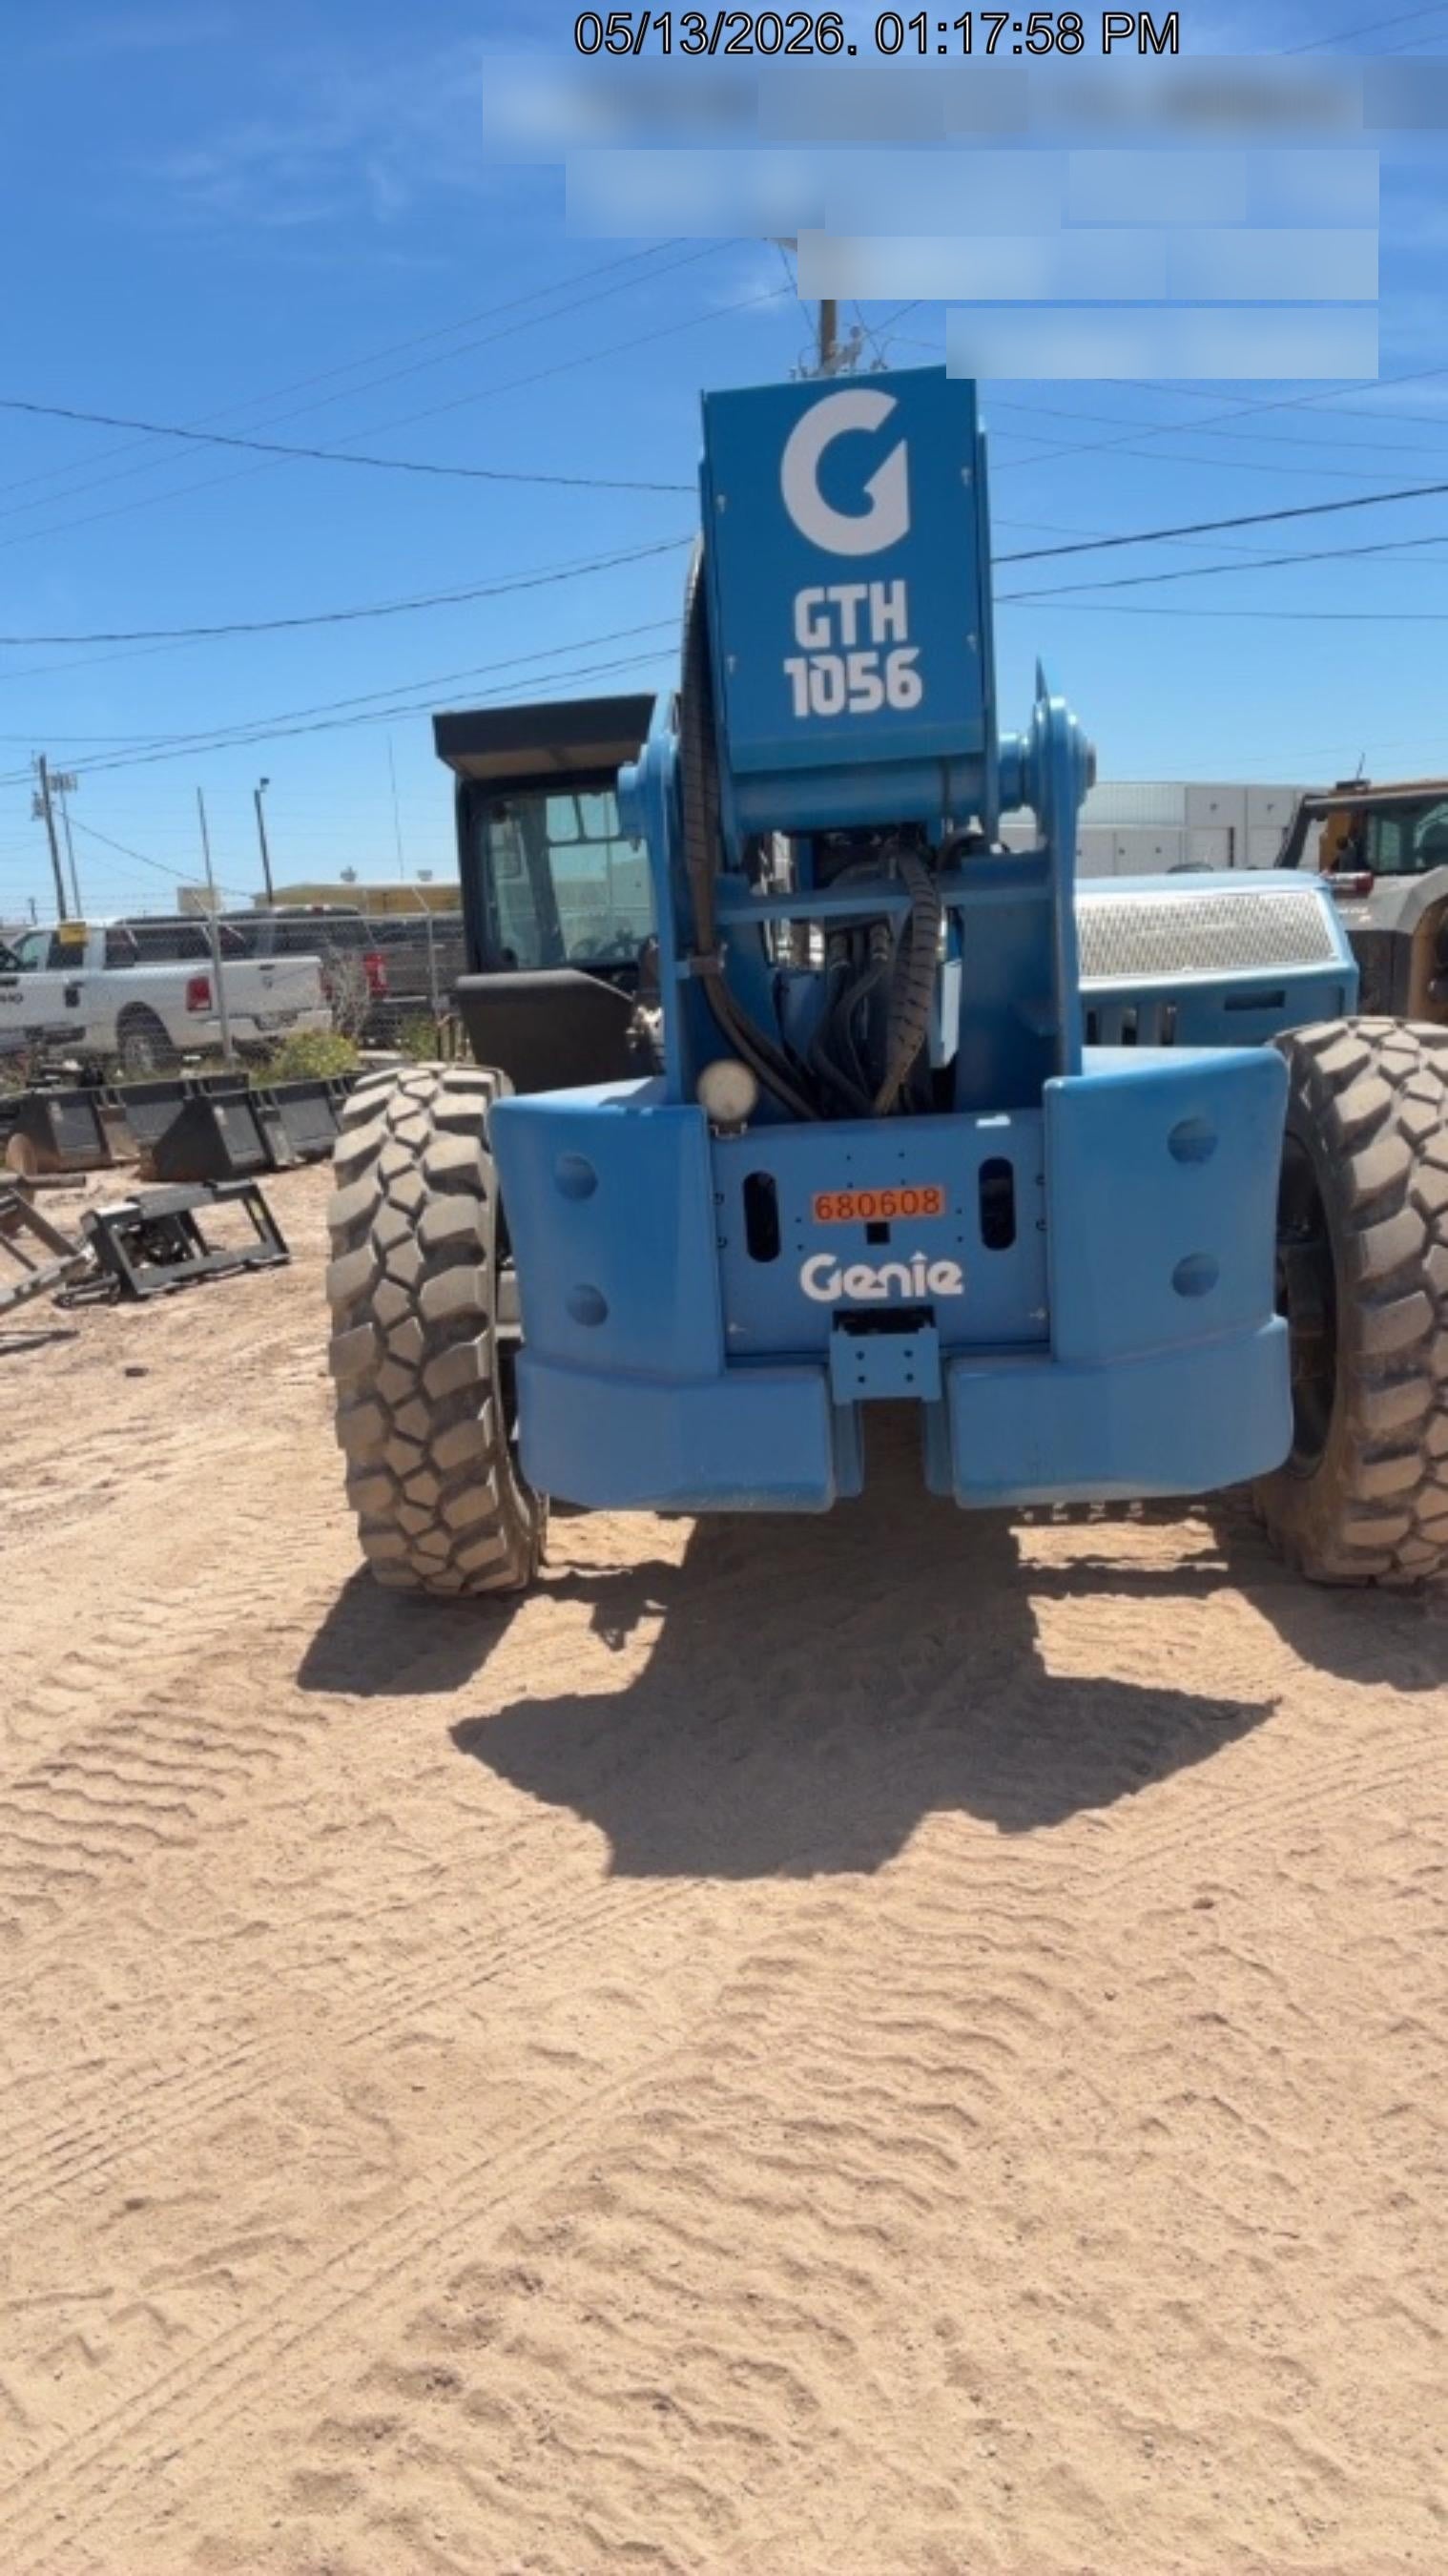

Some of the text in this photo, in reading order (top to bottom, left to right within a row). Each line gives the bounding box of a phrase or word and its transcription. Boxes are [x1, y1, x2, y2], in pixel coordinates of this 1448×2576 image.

[780, 388, 910, 556] G
[794, 579, 908, 650] GTH
[783, 648, 923, 718] 1056
[816, 1188, 940, 1220] 680608
[800, 1251, 964, 1301] Genie
